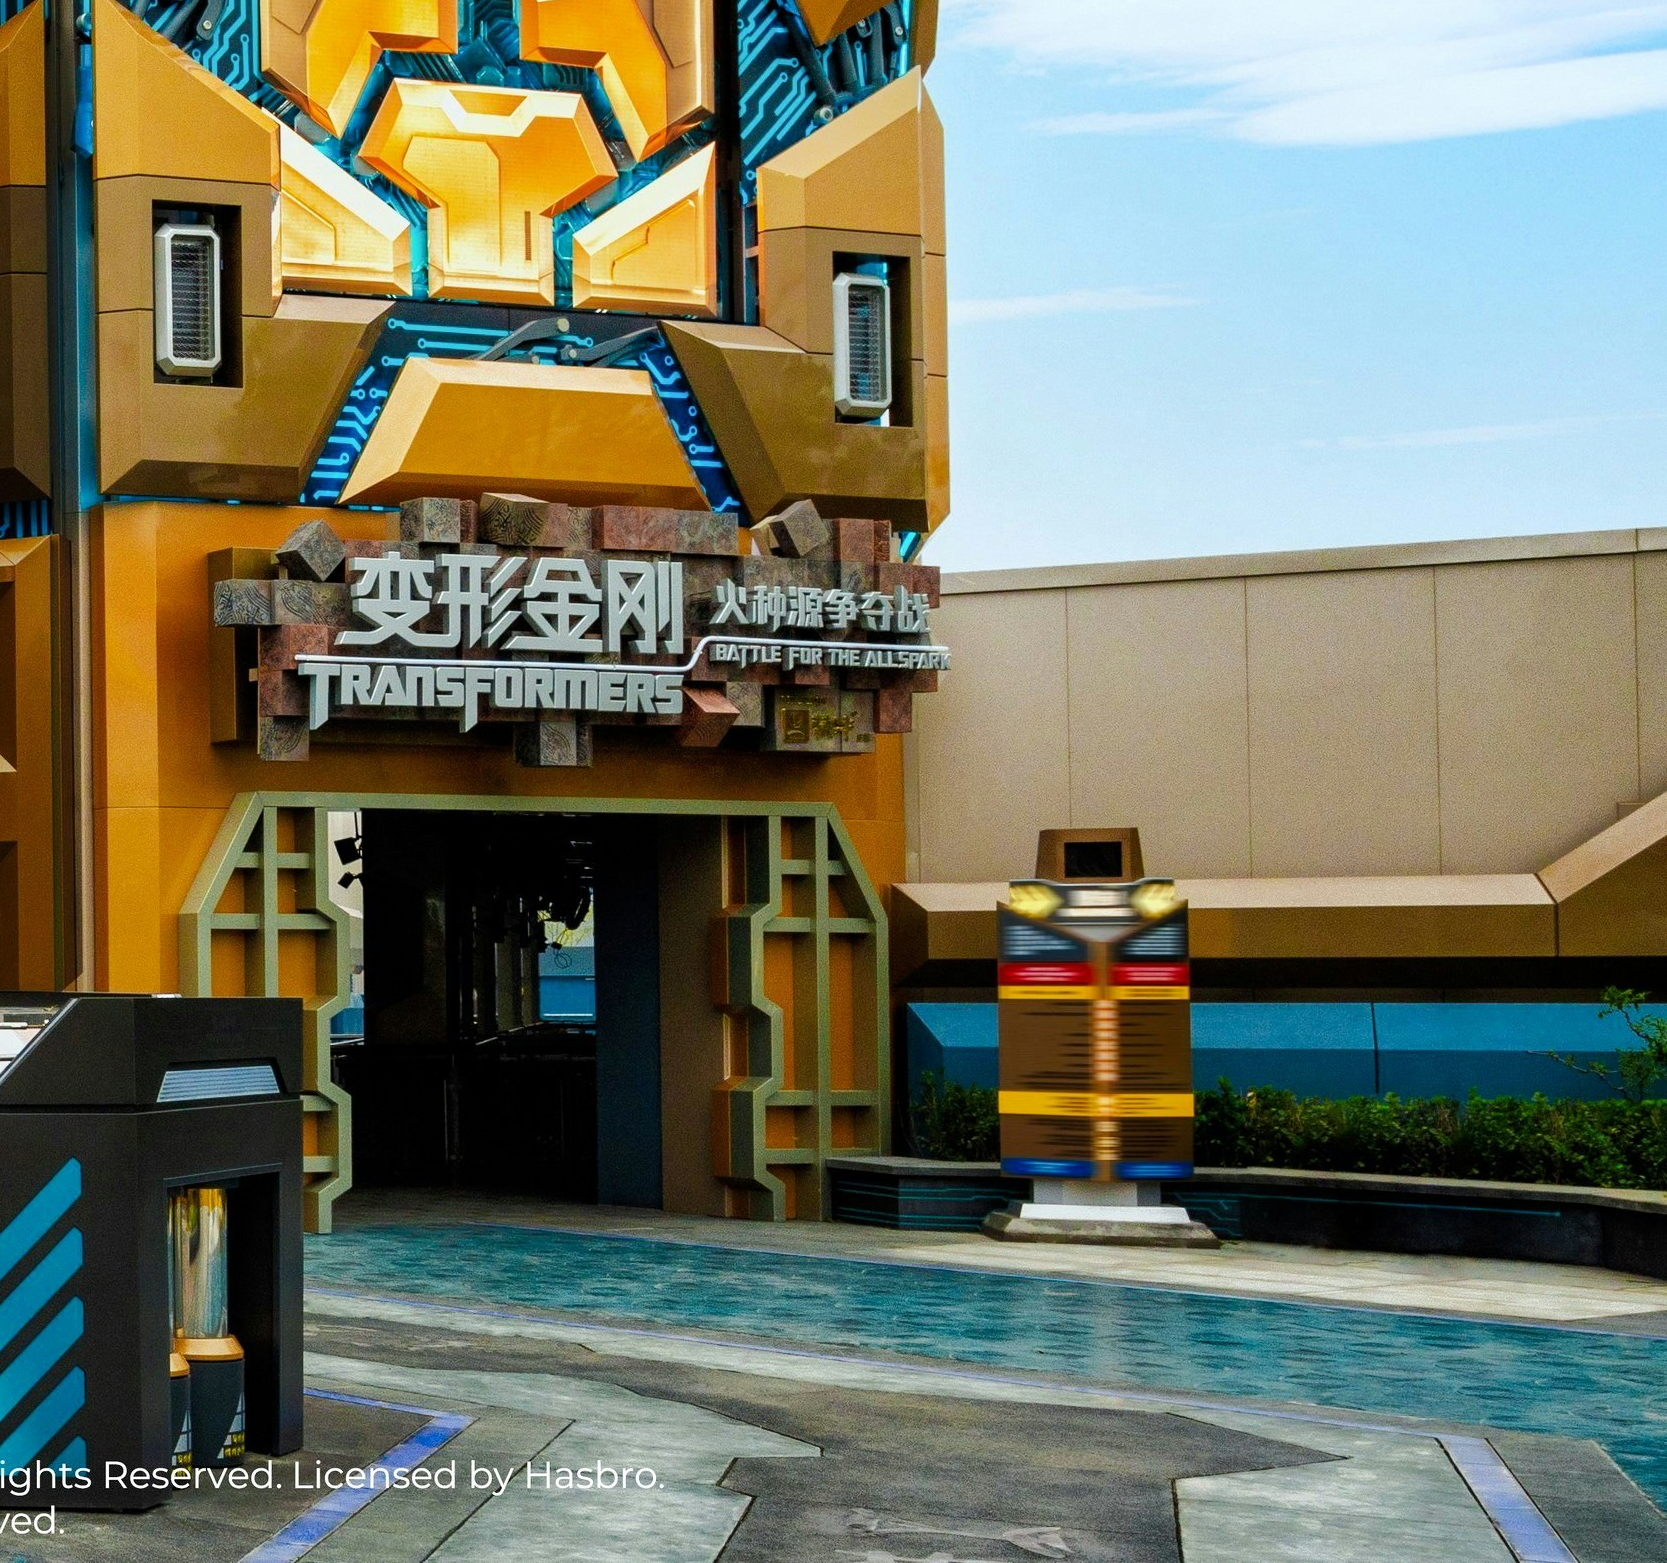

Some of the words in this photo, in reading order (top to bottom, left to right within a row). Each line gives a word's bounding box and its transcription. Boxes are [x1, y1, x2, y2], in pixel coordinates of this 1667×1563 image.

[334, 551, 684, 655] 变形金刚
[709, 578, 930, 633] 火种源争夺战
[712, 643, 782, 669] BATTLE
[786, 646, 823, 671] FOR
[826, 648, 861, 666] THE
[864, 650, 951, 671] ALLSPARK
[297, 662, 685, 734] TRANSFORMERS
